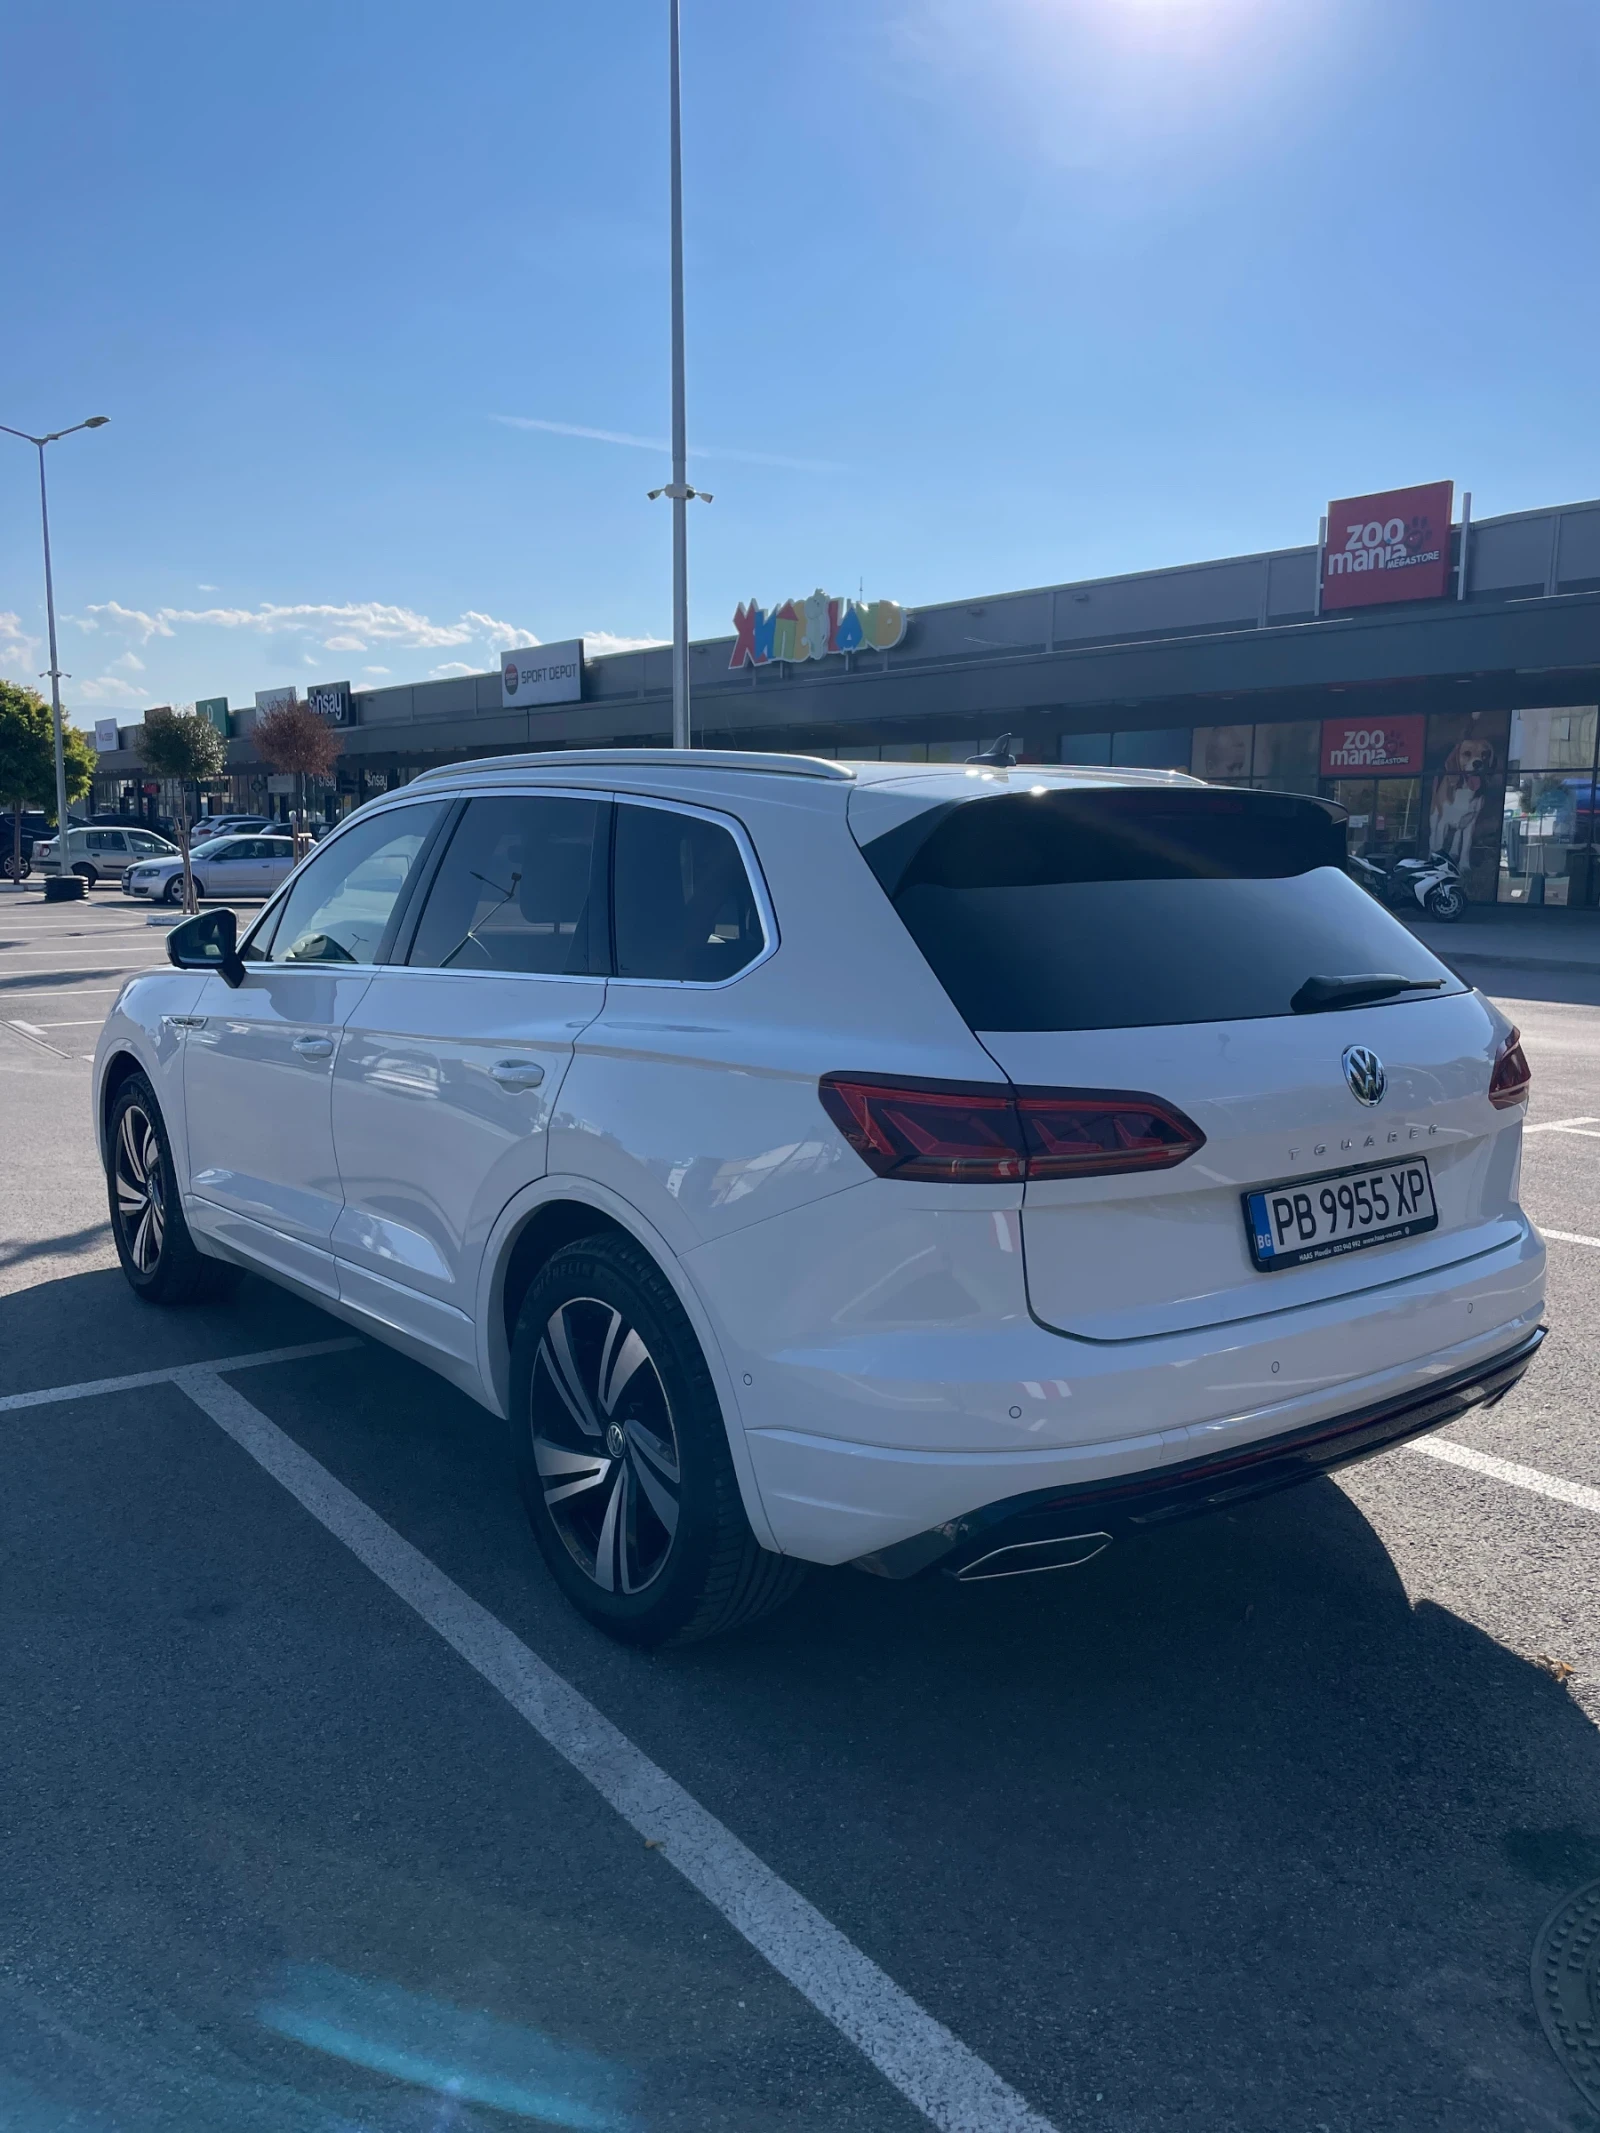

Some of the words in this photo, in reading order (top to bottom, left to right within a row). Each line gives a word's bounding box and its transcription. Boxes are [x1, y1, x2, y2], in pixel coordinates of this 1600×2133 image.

[1328, 543, 1407, 575] mania
[1386, 551, 1440, 569] MEGASTORE
[521, 667, 547, 684] SPORT
[549, 663, 577, 680] DEPOT
[1330, 748, 1387, 766] mania
[1372, 756, 1409, 766] MEGASTORE
[1288, 1124, 1438, 1160] TOUAREG
[1272, 1193, 1317, 1246] PB
[1320, 1177, 1390, 1234] 9955
[1391, 1169, 1424, 1217] XP
[1257, 1233, 1272, 1249] BG
[1299, 1251, 1313, 1262] HAAS
